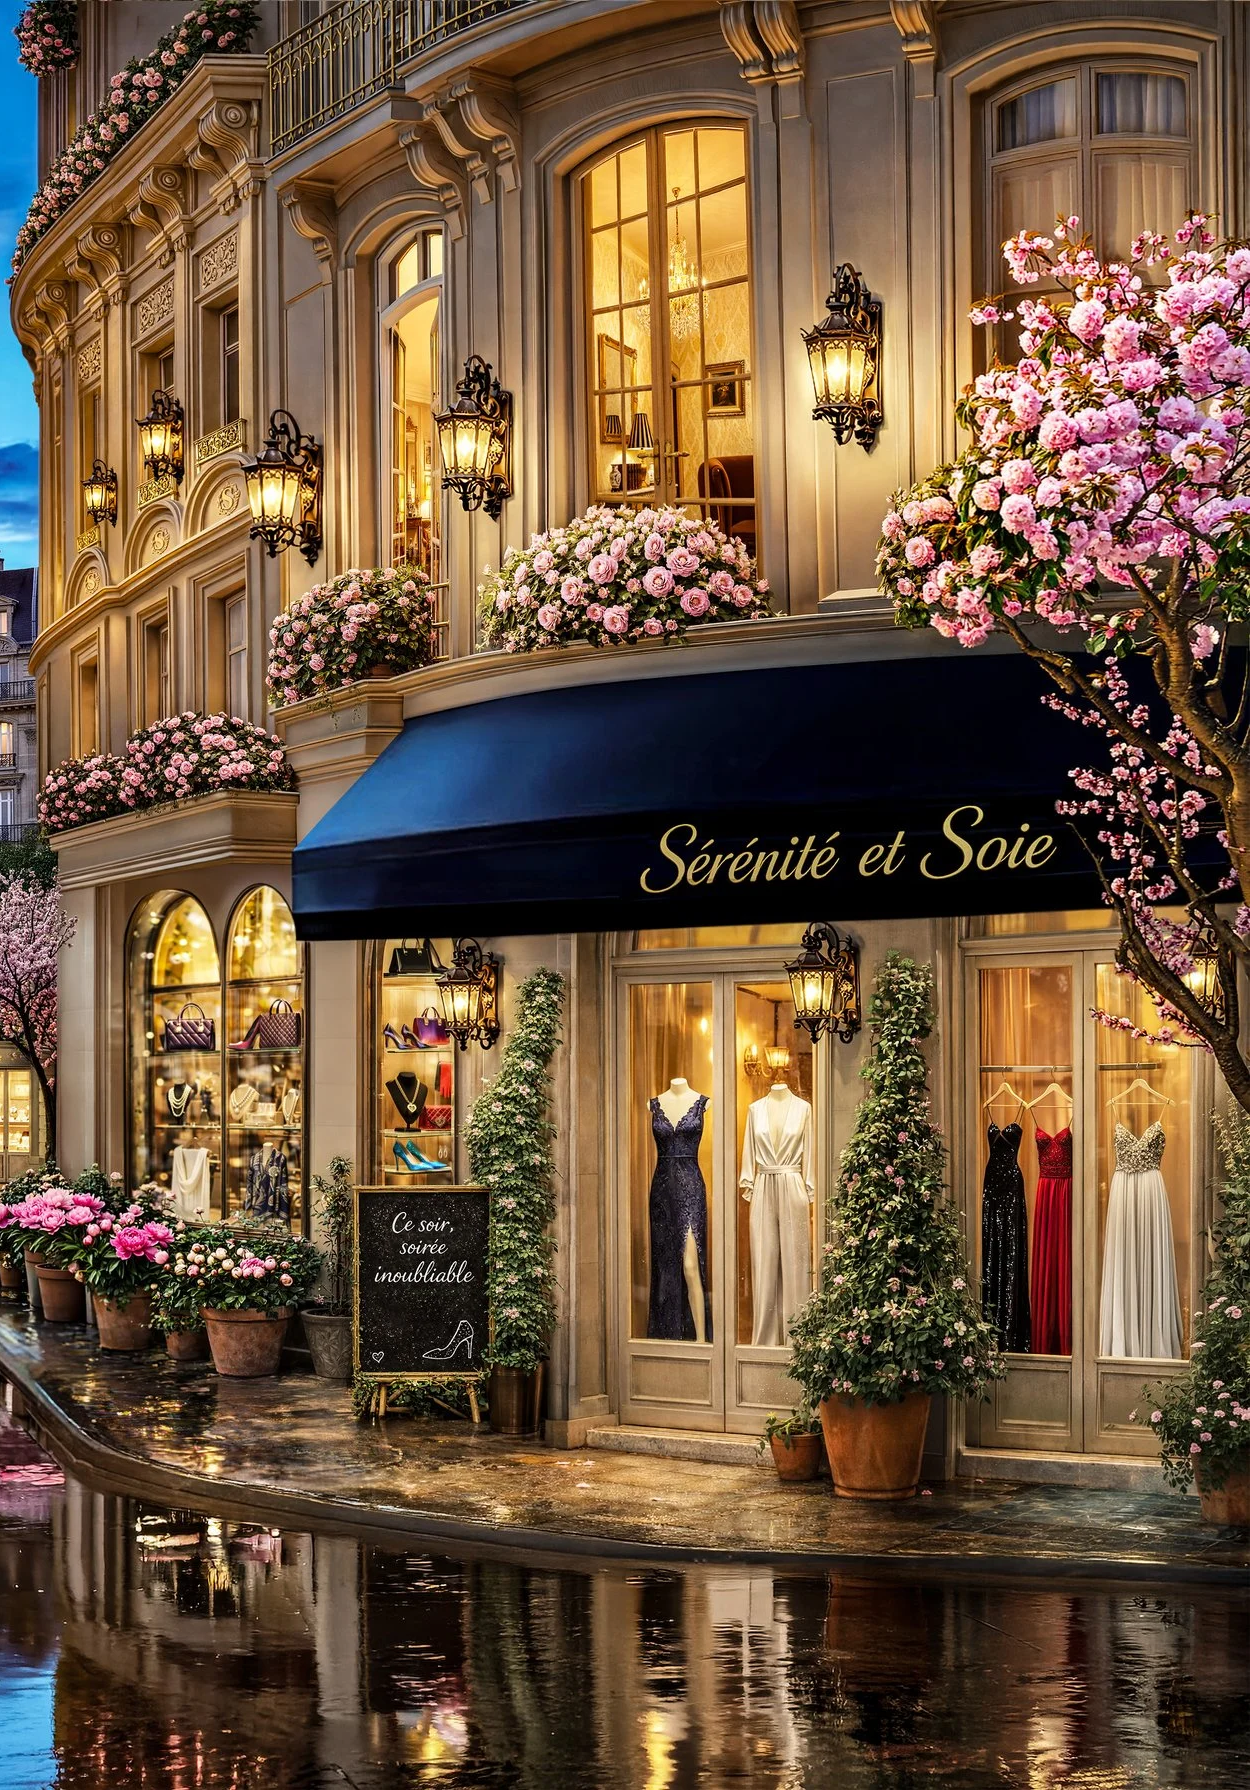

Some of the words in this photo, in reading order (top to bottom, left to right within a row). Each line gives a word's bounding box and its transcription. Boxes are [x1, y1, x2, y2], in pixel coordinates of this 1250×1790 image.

[639, 823, 841, 894] Sérénité
[858, 830, 906, 878] et
[919, 805, 1058, 880] Soie
[392, 1212, 415, 1233] Ce
[419, 1217, 454, 1234] soir,
[399, 1239, 448, 1254] soirée
[374, 1260, 474, 1283] inoubliable
